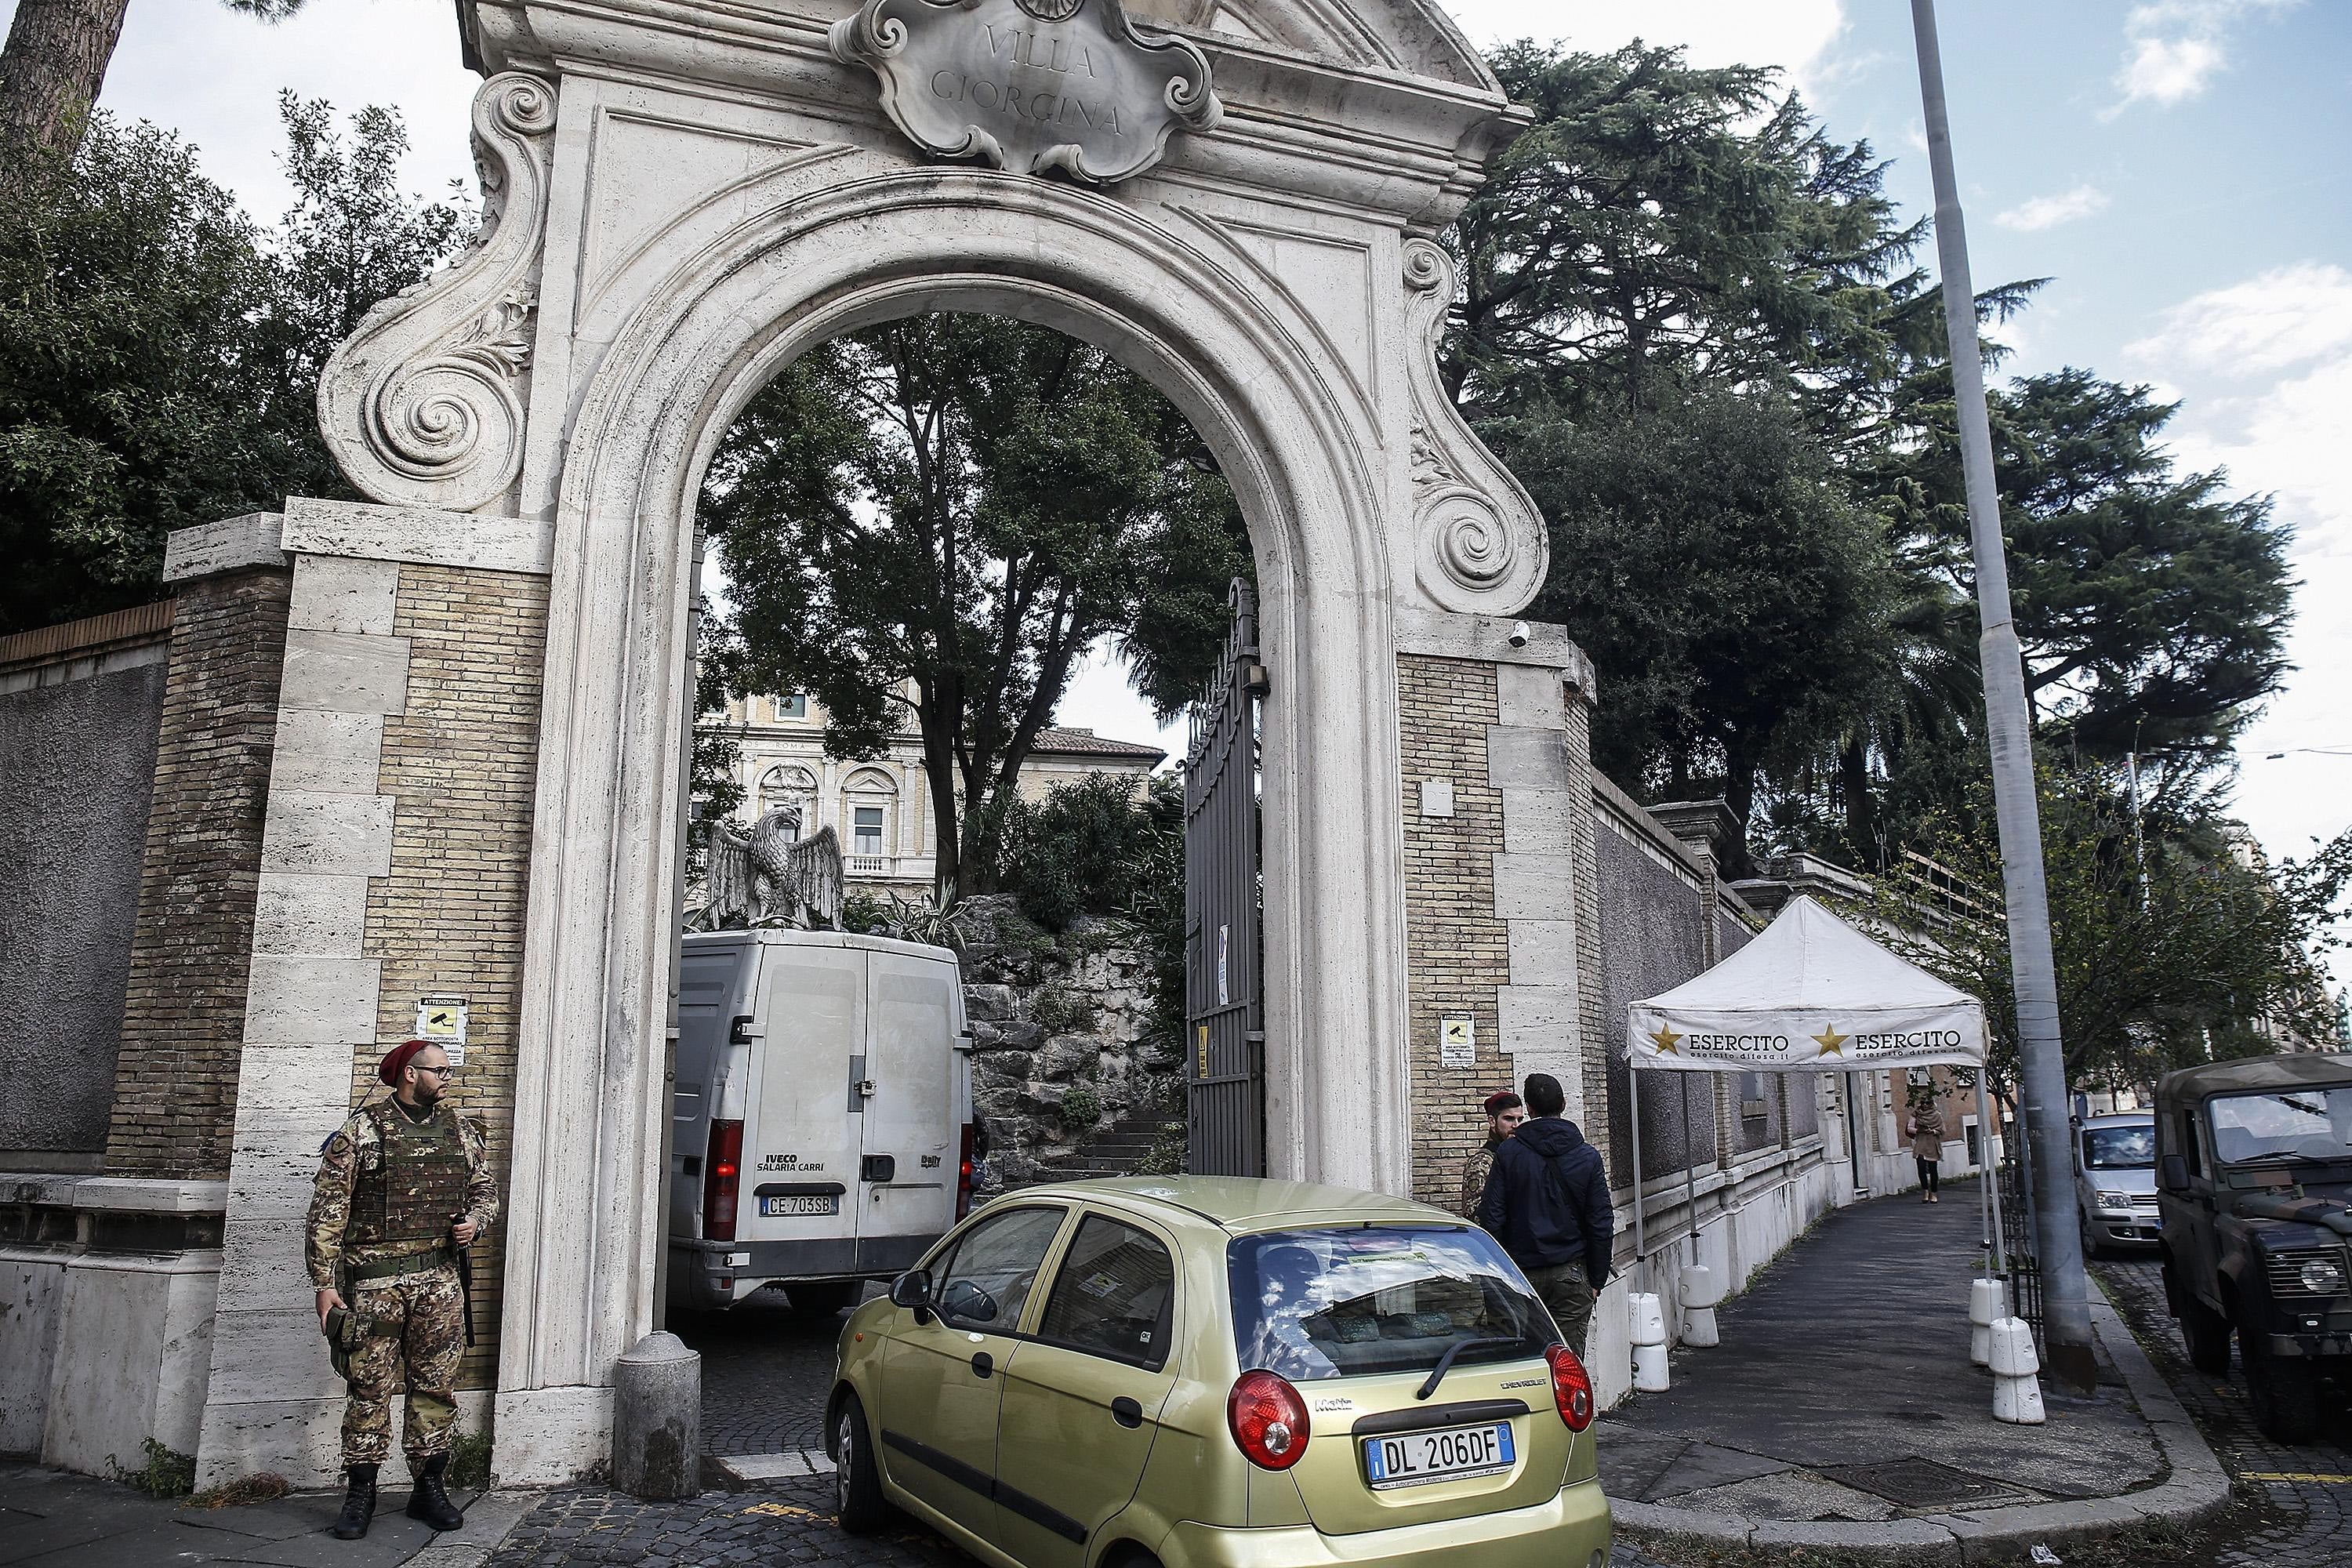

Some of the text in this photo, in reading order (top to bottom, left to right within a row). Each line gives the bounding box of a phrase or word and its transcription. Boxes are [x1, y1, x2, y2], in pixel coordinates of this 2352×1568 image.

[983, 23, 1096, 79] VILLA
[930, 70, 1123, 136] GIORGINA
[1689, 1034, 1789, 1051] ESERCITO
[1855, 1030, 1962, 1050] ESERCITO
[1690, 1051, 1789, 1060] esercito.difesa.it
[1855, 1047, 1962, 1058] esercito.difesa.it
[765, 1154, 797, 1163] IVECO
[757, 1163, 824, 1171] SALARIA CARRI
[1500, 1377, 1547, 1389] CHEVROLET
[1315, 1398, 1352, 1412] Matiz
[1385, 1439, 1417, 1475] DL
[1424, 1429, 1496, 1469] 206DF
